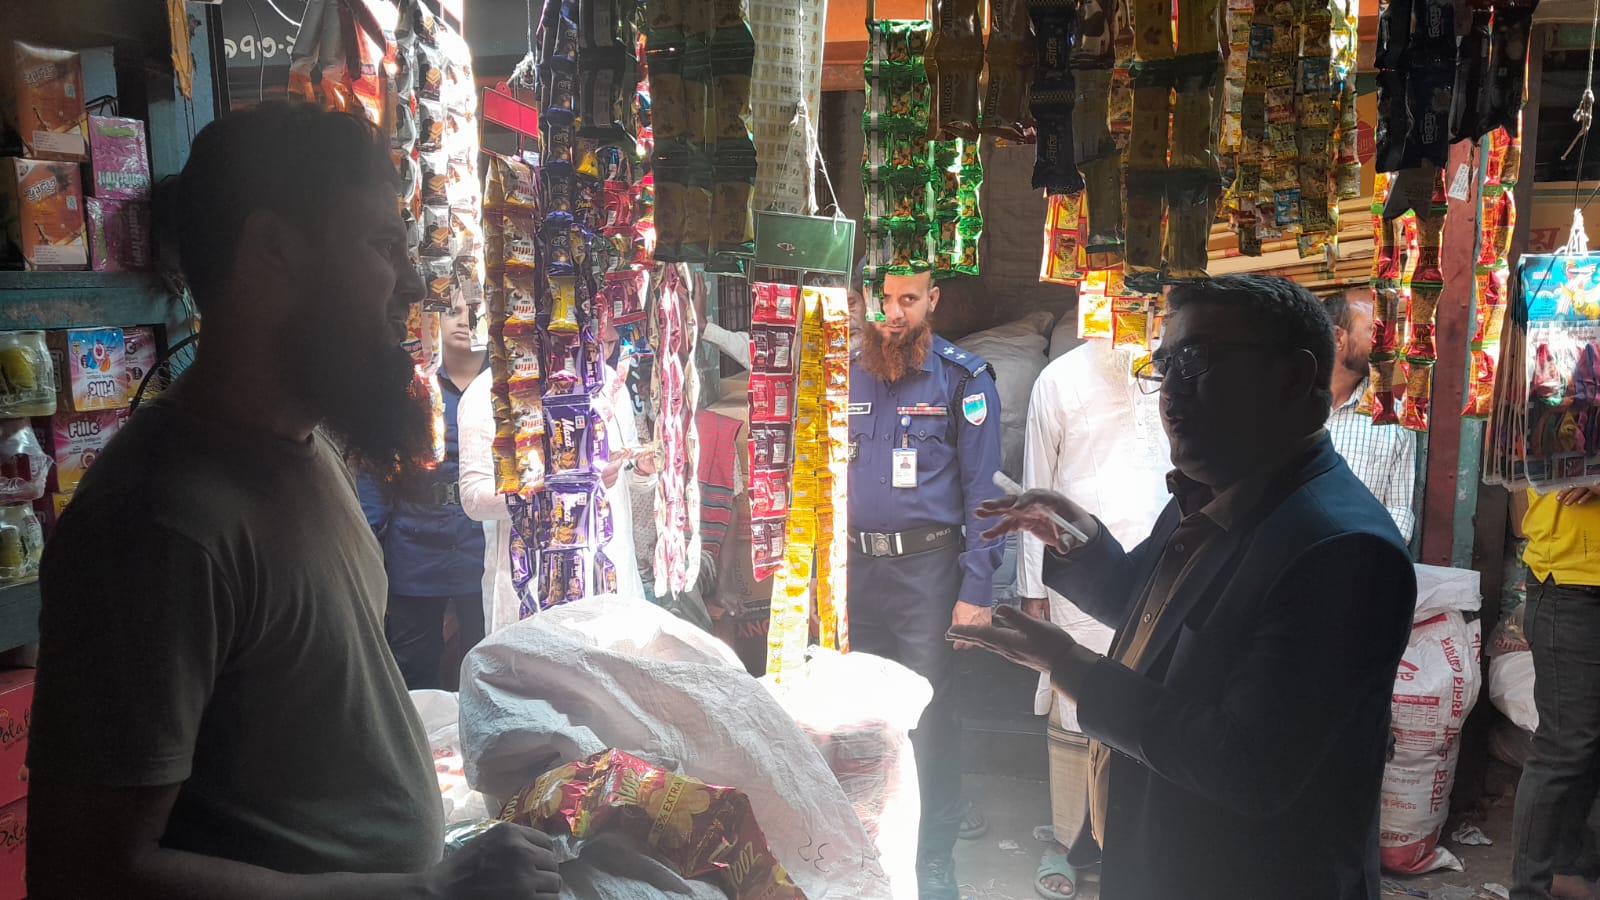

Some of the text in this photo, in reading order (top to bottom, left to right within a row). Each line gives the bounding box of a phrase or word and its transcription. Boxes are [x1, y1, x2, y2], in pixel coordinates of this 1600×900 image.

[512, 245, 535, 256] Tiffin
[512, 304, 535, 314] Tiffin
[514, 362, 539, 372] Tiffin
[662, 779, 683, 812] EXTRA
